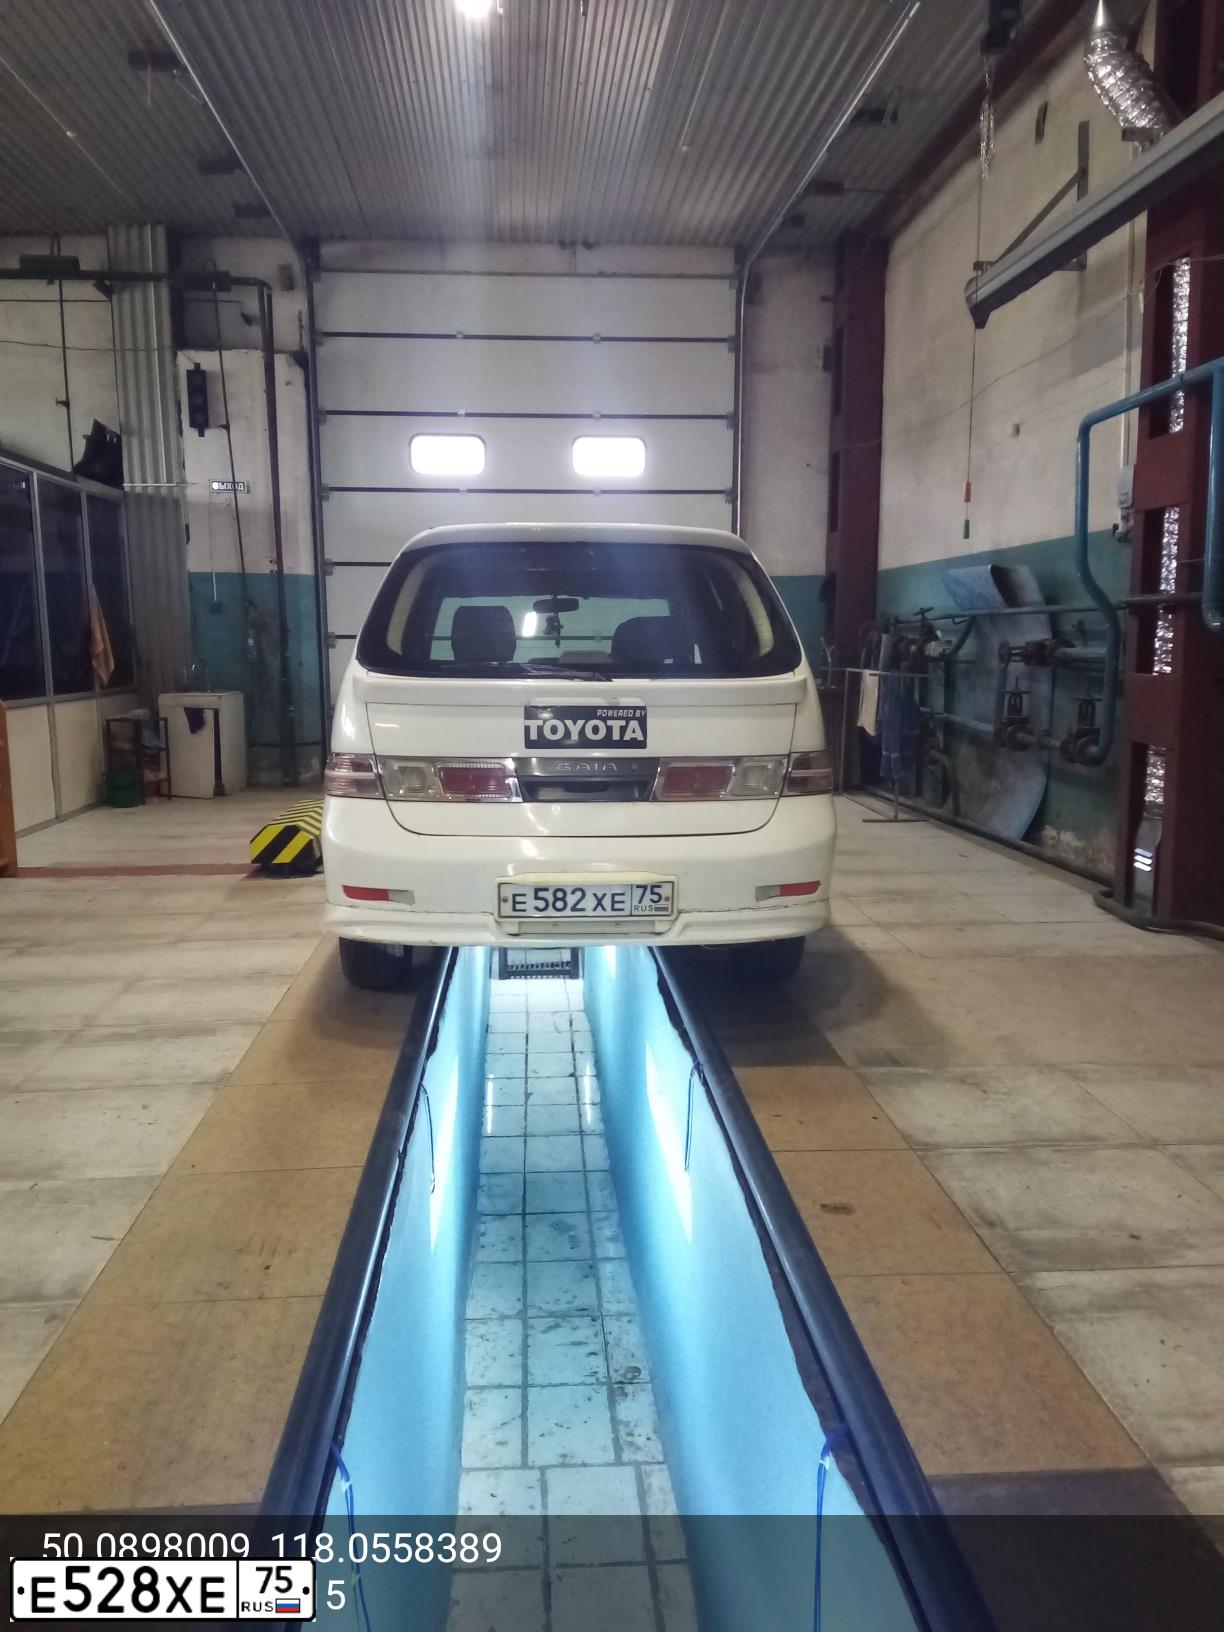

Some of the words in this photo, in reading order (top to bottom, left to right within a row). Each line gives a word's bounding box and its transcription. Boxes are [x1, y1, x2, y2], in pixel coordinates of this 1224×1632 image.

[212, 481, 244, 491] ЫХД
[597, 709, 634, 717] POWERED
[635, 709, 646, 717] BY
[524, 719, 645, 741] TOYOTA
[556, 762, 618, 772] GAIA
[635, 885, 663, 904] 75
[633, 904, 654, 912] RUS
